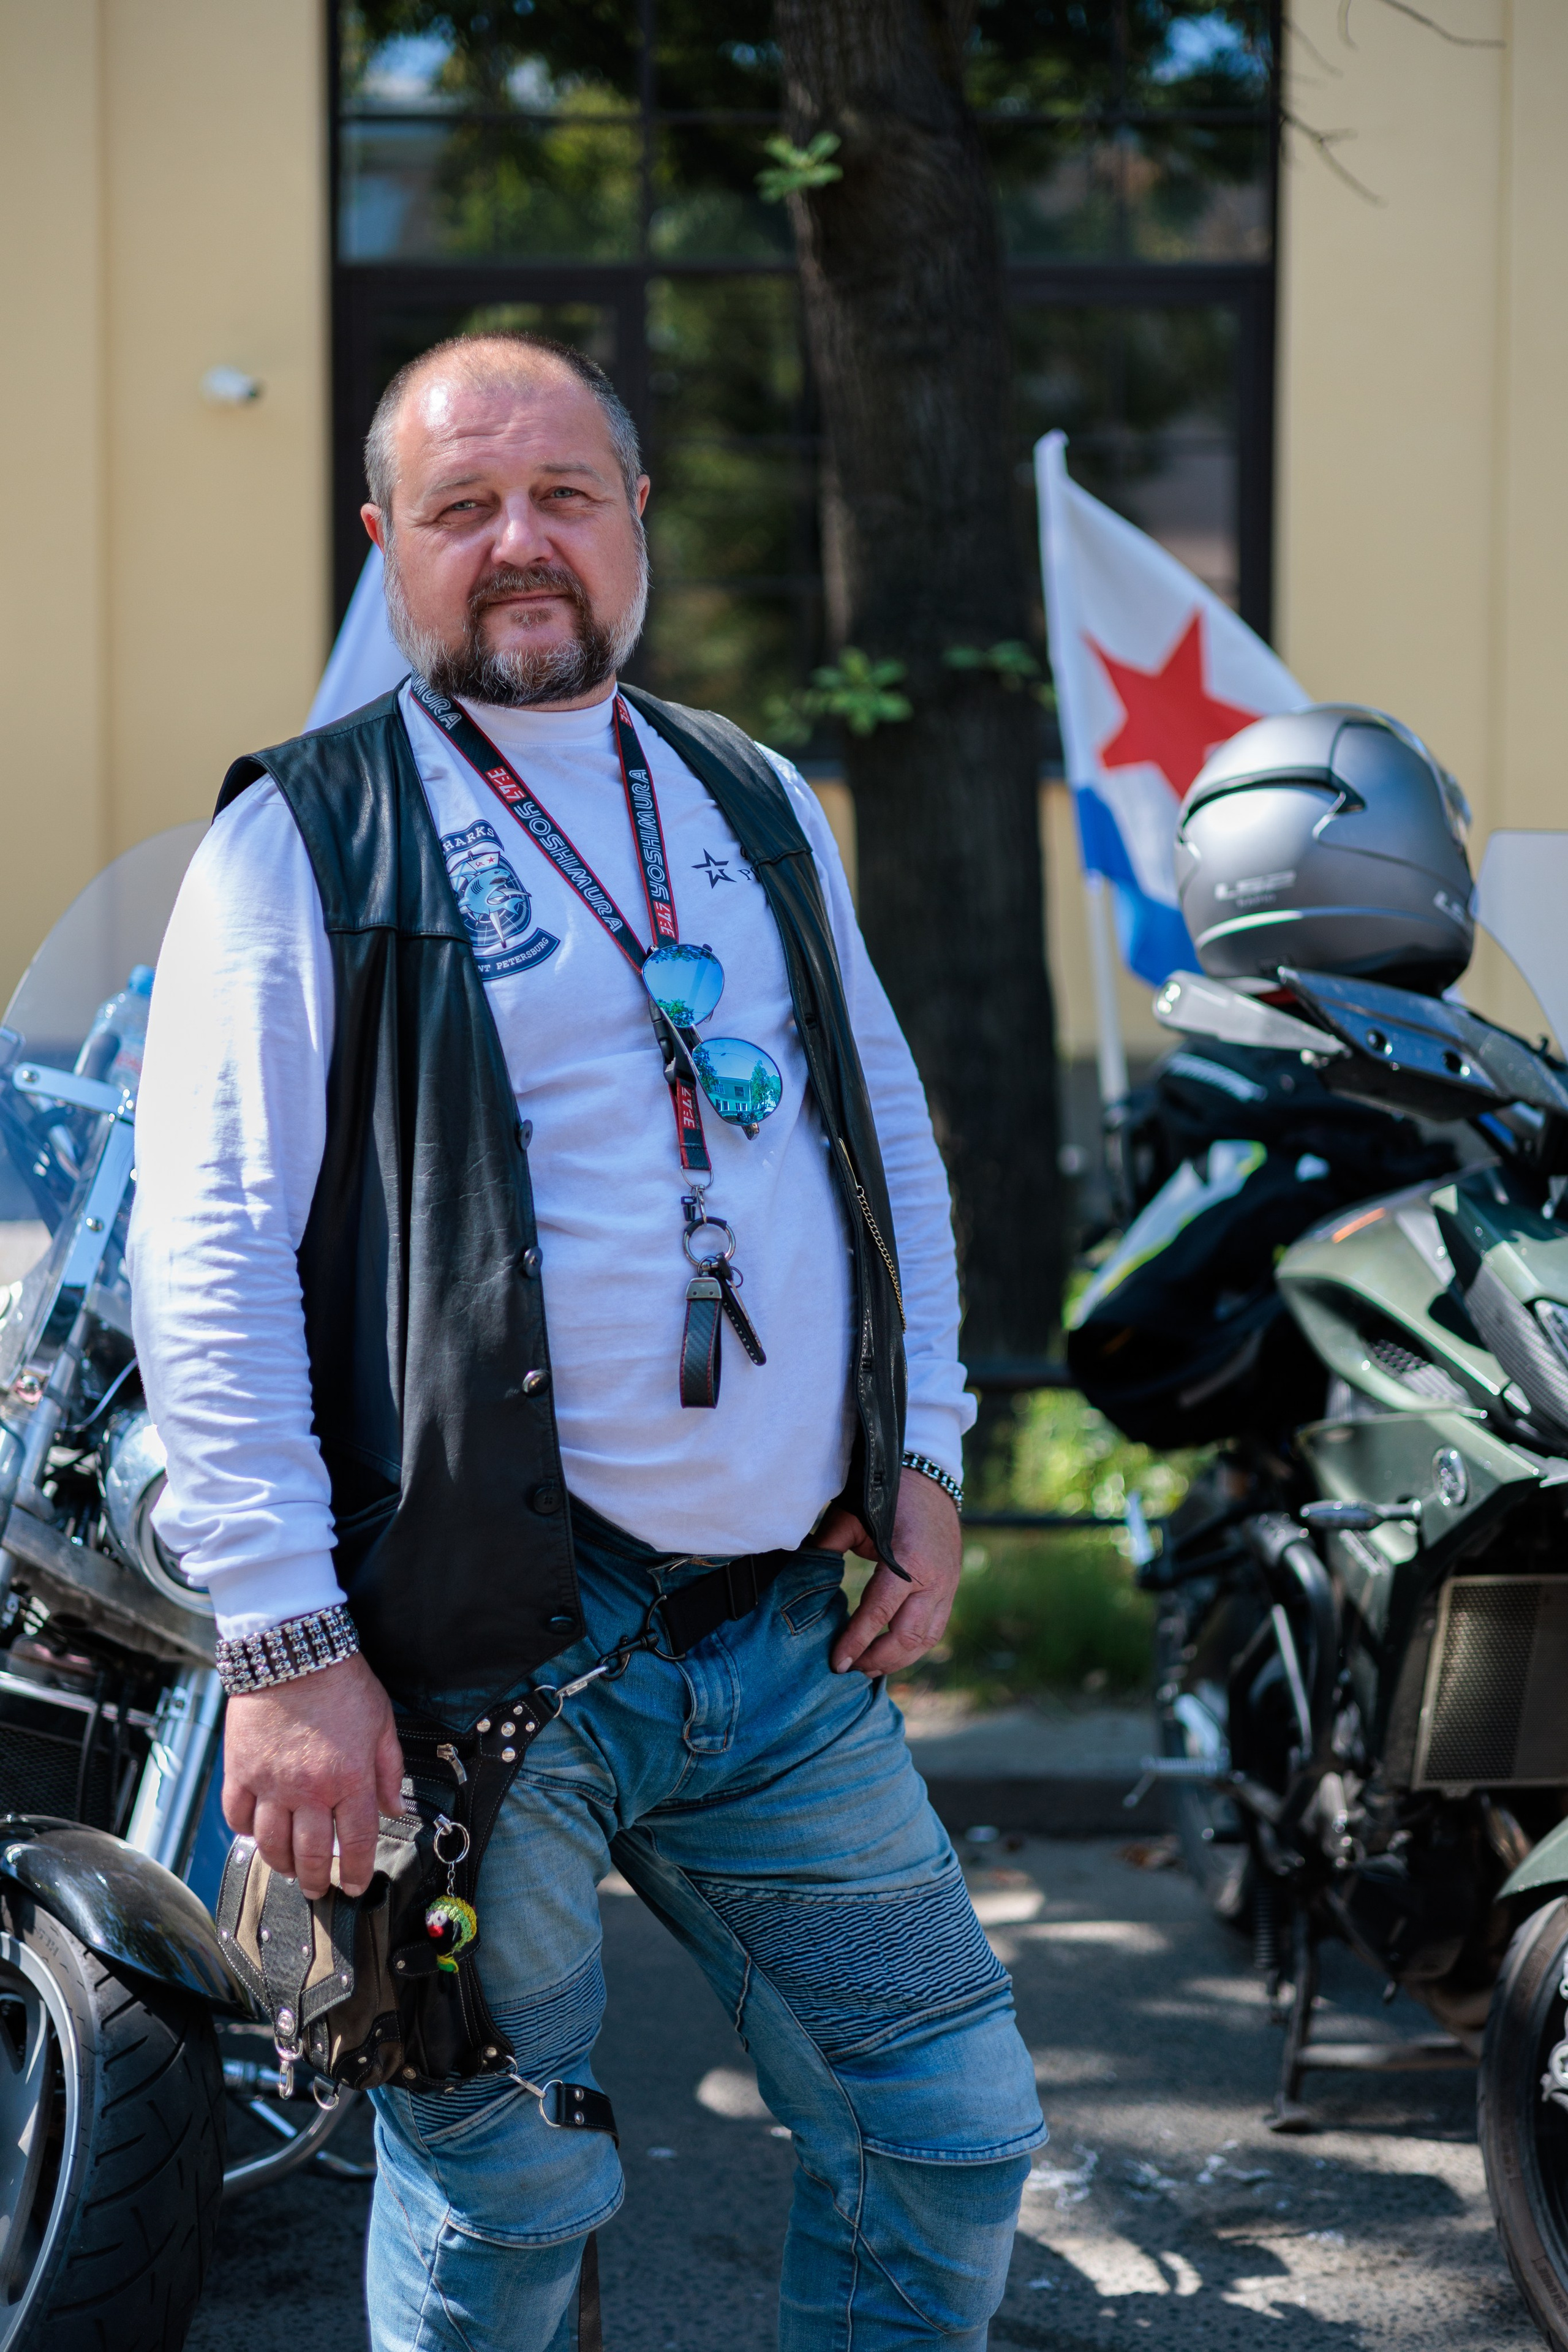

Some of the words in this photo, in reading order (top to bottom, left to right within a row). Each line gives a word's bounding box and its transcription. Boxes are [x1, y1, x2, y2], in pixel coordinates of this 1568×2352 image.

[442, 826, 495, 856] HARKS
[513, 801, 623, 933] YOSHIMURA
[628, 769, 669, 900] YOSHIMURA
[477, 964, 491, 973] NT
[496, 937, 549, 970] PETERSBURG
